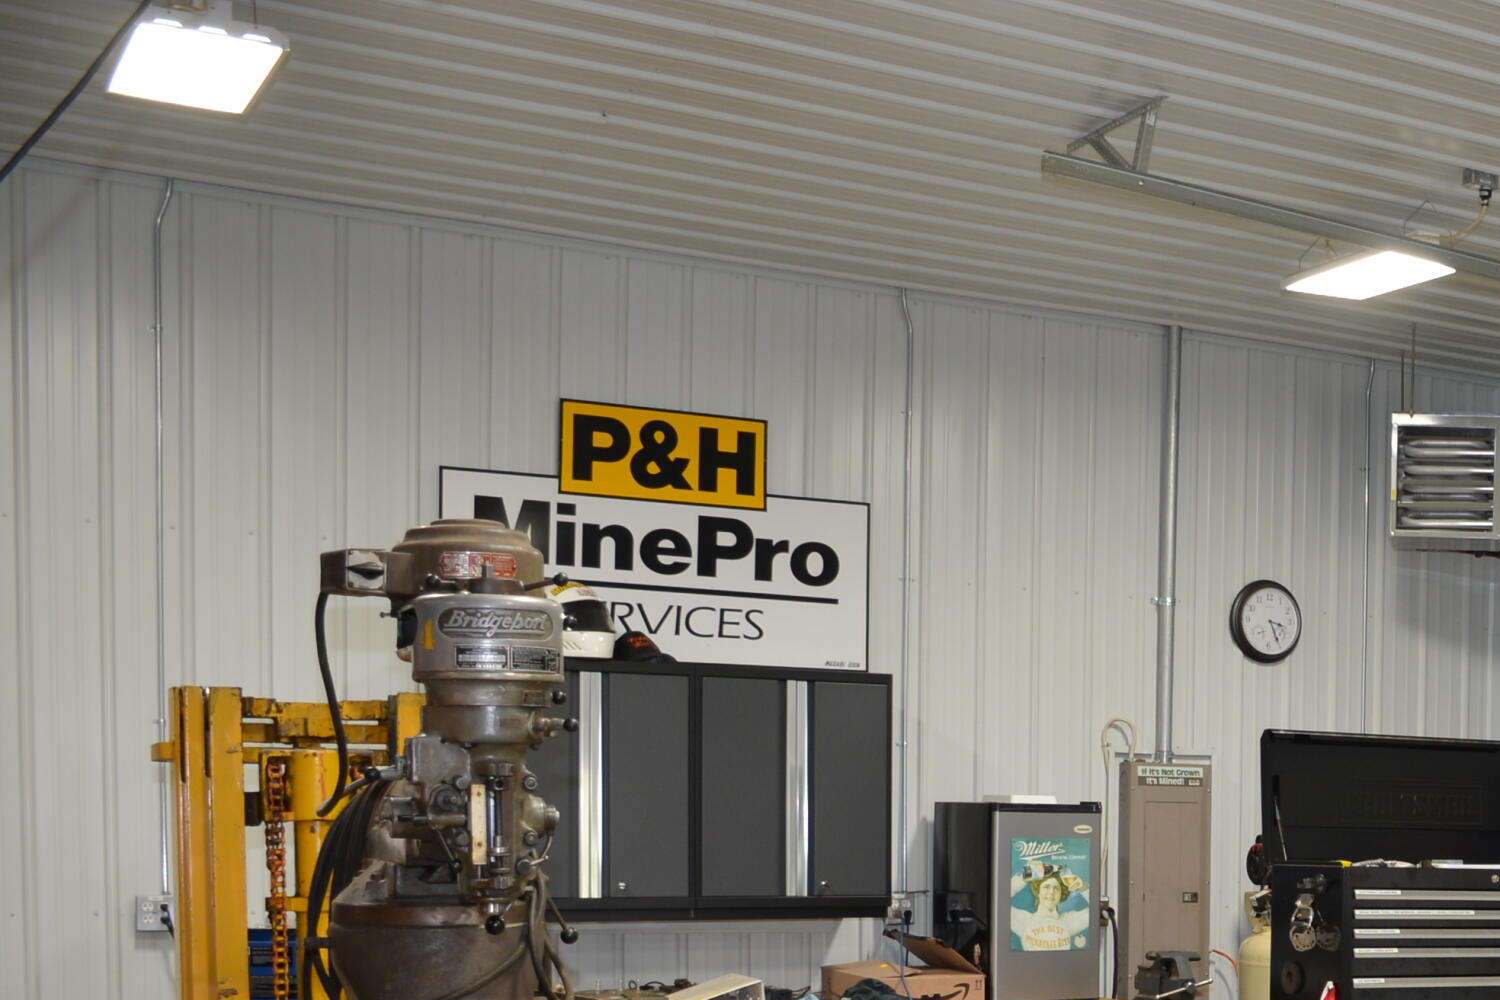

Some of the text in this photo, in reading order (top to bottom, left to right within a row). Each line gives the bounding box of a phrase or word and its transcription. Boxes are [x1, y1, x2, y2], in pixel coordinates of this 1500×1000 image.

[572, 413, 756, 496] P&H
[473, 495, 840, 587] MinePro
[444, 609, 548, 638] Bridgeport
[609, 601, 764, 641] RVICES
[1161, 768, 1175, 776] Not
[1176, 768, 1200, 777] Grown
[1016, 840, 1066, 859] Miller
